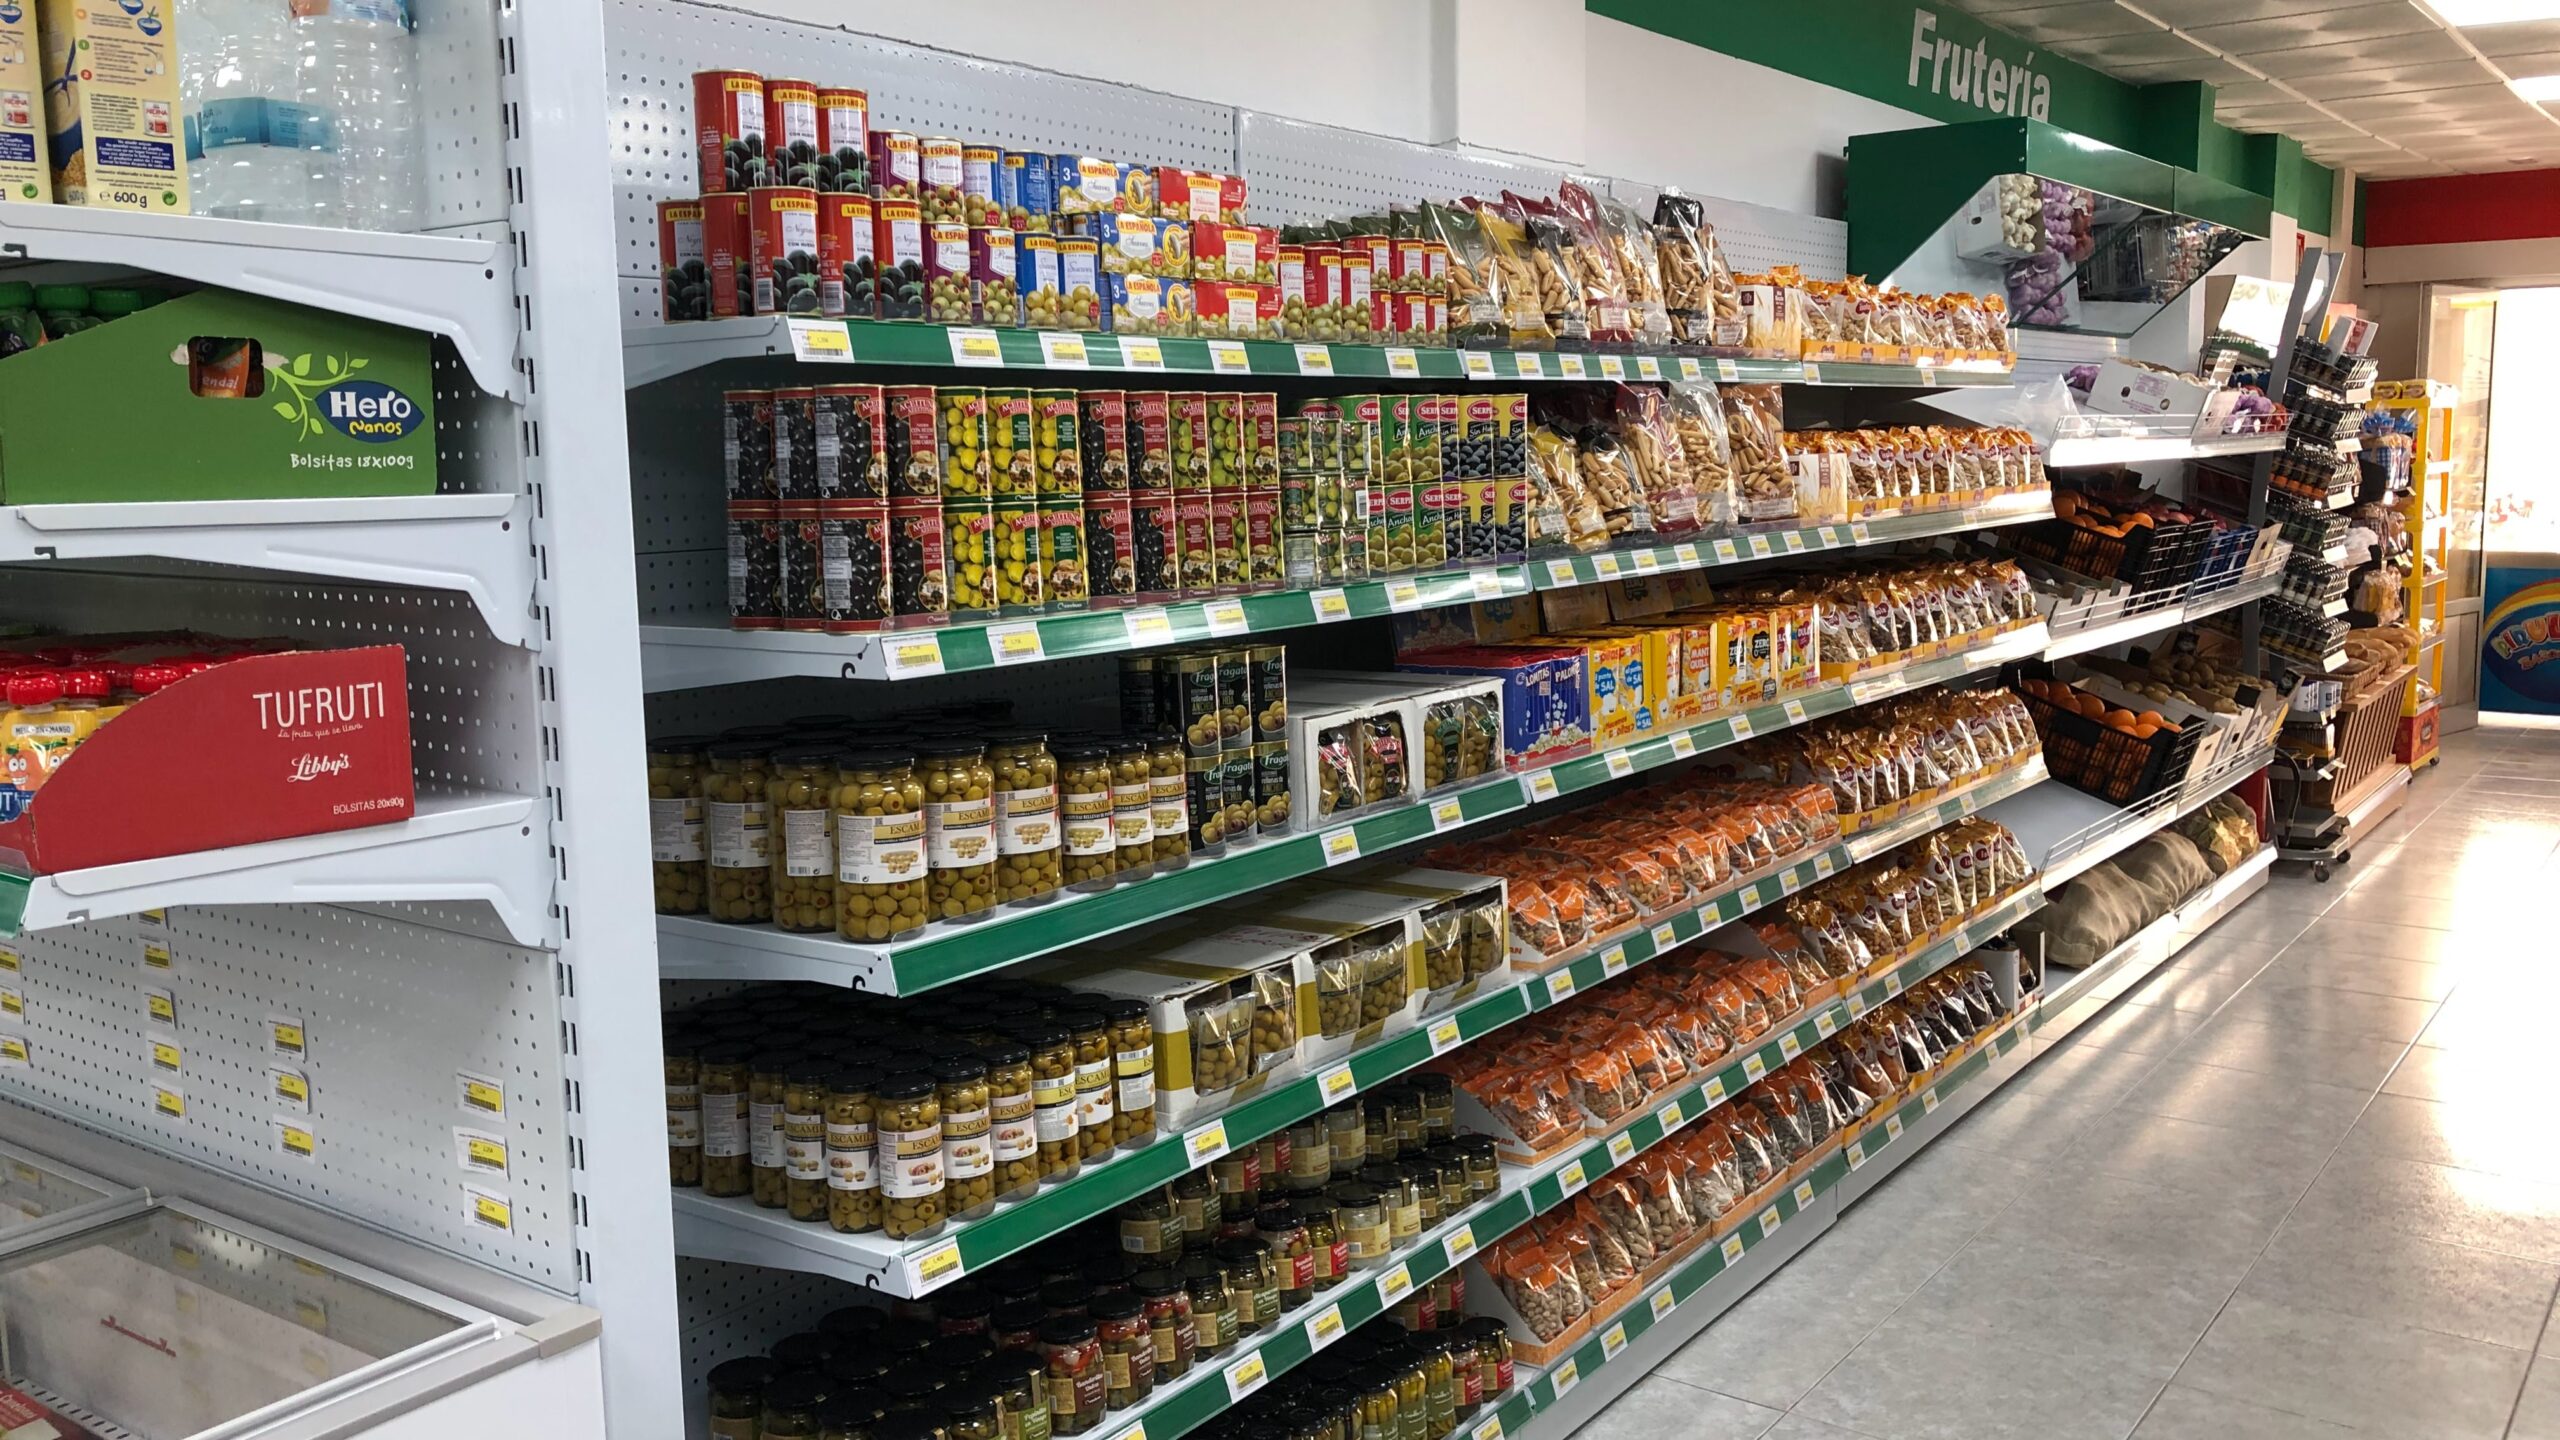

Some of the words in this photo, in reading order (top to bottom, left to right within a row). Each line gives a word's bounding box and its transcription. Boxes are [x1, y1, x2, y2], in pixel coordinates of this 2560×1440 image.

[1908, 8, 2051, 123] Frutería
[1063, 167, 1071, 182] 3
[114, 191, 138, 203] 600
[140, 195, 147, 208] g
[1104, 224, 1110, 238] 3
[1114, 284, 1121, 299] 3
[329, 390, 412, 419] Hero
[349, 420, 403, 436] Nanos
[290, 453, 353, 472] Bolsitas
[1601, 681, 1615, 692] SAL
[252, 681, 385, 730] TUFRUTI
[278, 728, 290, 738] La
[292, 728, 314, 742] fruta
[315, 729, 330, 741] que
[286, 753, 350, 783] Libby's
[333, 800, 376, 815] BOLSITAS
[377, 796, 405, 809] 20x90g
